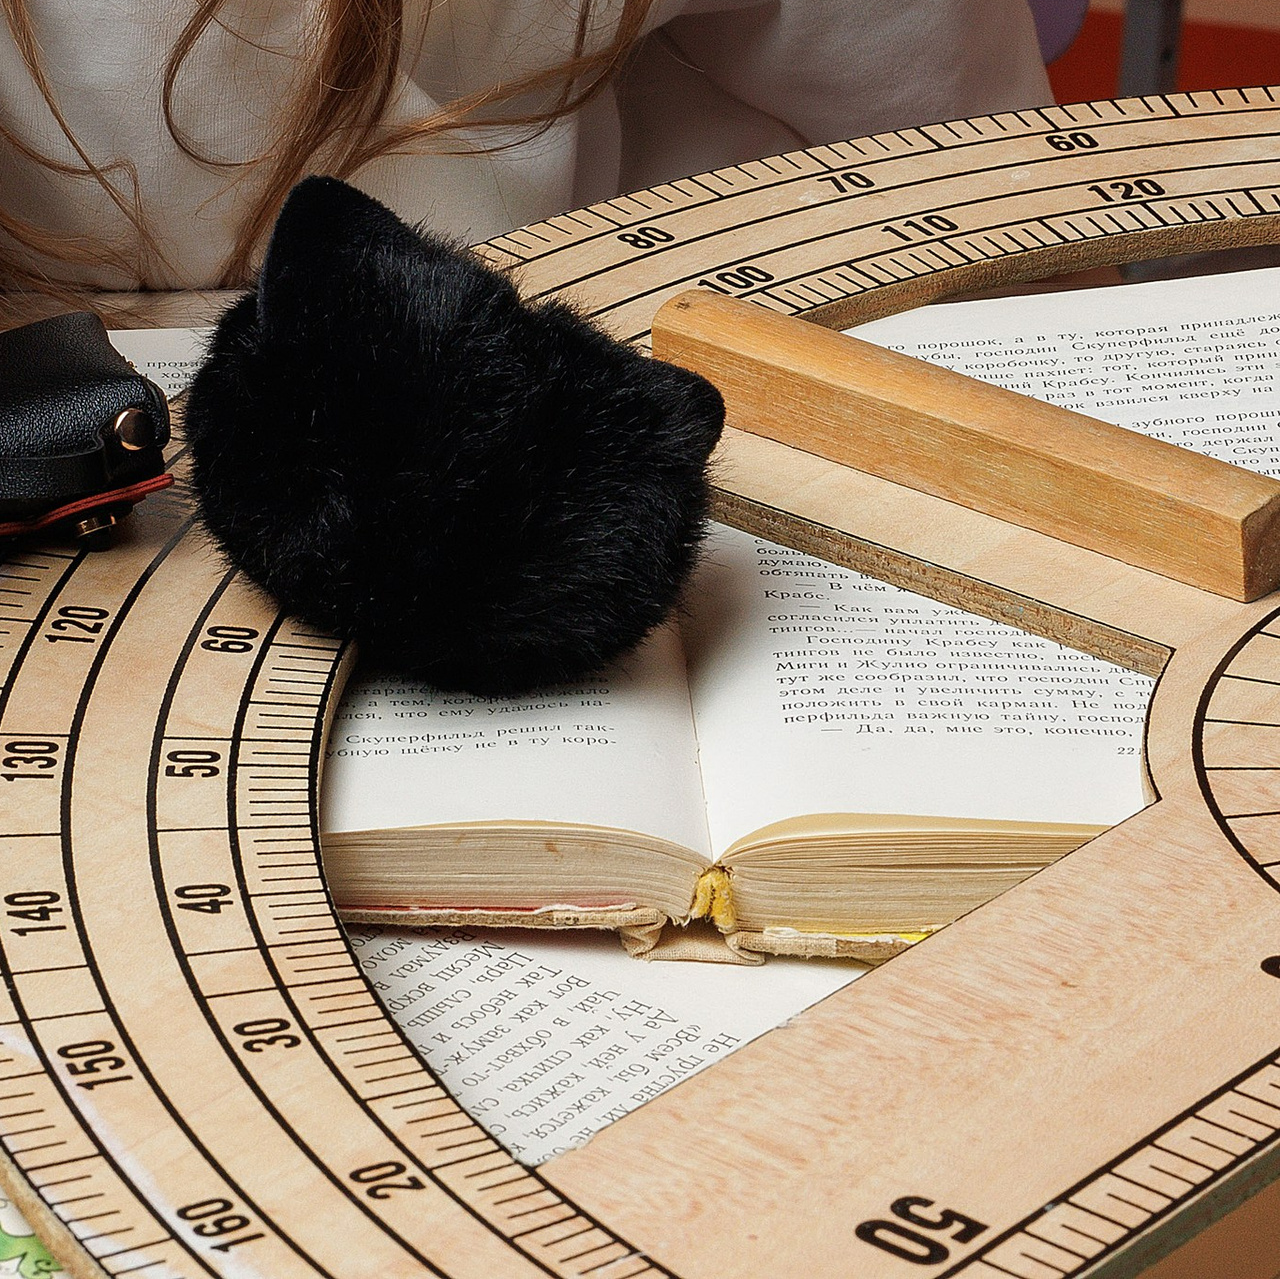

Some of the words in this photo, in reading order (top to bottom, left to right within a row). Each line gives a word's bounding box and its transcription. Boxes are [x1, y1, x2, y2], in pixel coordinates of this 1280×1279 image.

[1047, 130, 1100, 154] 60
[823, 171, 876, 195] 70
[1087, 177, 1166, 201] 120
[617, 226, 675, 251] 80
[881, 214, 959, 242] 110
[697, 266, 775, 294] 100
[917, 339, 1003, 351] порошок,
[1057, 331, 1083, 342] ту,
[1095, 325, 1168, 338] которая
[975, 345, 1057, 358] господин
[1072, 334, 1197, 351] Скуперфильд
[1209, 328, 1245, 339] ещё
[964, 359, 1065, 372] коробочку,
[1074, 355, 1094, 363] то
[1103, 348, 1175, 362] другую,
[1184, 341, 1267, 354] стараясь
[1024, 368, 1093, 378] пахнет:
[1102, 364, 1137, 372] тот,
[1147, 354, 1224, 367] который
[1126, 367, 1226, 381] Кончились
[1235, 364, 1265, 372] эти
[1045, 391, 1076, 401] раз
[1102, 387, 1132, 395] тот
[1141, 380, 1214, 392] момент,
[1223, 373, 1274, 385] когда
[1096, 394, 1169, 408] взвился
[1179, 387, 1242, 400] кверху
[1252, 385, 1273, 393] на
[1132, 416, 1205, 429] зубного
[1182, 423, 1267, 437] господин
[1202, 436, 1274, 447] держал
[757, 558, 829, 569] думаю,
[759, 568, 849, 579] обтяпать
[764, 590, 830, 601] Крабс.
[829, 582, 843, 590] В
[851, 583, 886, 592] чём
[767, 613, 879, 623] согласился
[889, 617, 980, 626] уплатить
[834, 604, 872, 613] Как
[45, 605, 112, 645] 120
[884, 627, 943, 635] начал
[200, 625, 262, 654] 60
[806, 635, 913, 647] Господину
[926, 638, 998, 648] Крабсу
[1012, 641, 1046, 649] как
[772, 648, 840, 659] тингов
[853, 648, 874, 656] не
[886, 648, 938, 657] было
[950, 650, 1045, 660] известно,
[775, 661, 829, 671] Миги
[856, 659, 928, 670] Жулио
[935, 661, 1101, 673] ограничивались
[776, 675, 809, 685] тут
[818, 674, 846, 682] же
[855, 672, 966, 683] сообразил,
[975, 675, 1008, 683] что
[1018, 676, 1110, 685] господин
[390, 699, 431, 707] тем,
[779, 687, 826, 697] этом
[837, 686, 882, 695] деле
[917, 686, 1022, 696] увеличить
[1034, 688, 1103, 699] сумму,
[782, 699, 882, 710] положить
[917, 698, 964, 707] свой
[977, 700, 1059, 710] карман.
[1071, 700, 1100, 709] Не
[394, 711, 428, 719] что
[439, 708, 475, 717] ему
[487, 701, 569, 716] удалось
[580, 699, 611, 707] на-
[783, 712, 895, 724] перфильда
[907, 712, 990, 722] важную
[1001, 712, 1067, 723] тайну,
[346, 730, 485, 746] Скуперфильд
[497, 724, 561, 737] решил
[573, 724, 615, 732] так-
[856, 724, 893, 734] Да,
[904, 725, 935, 734] да,
[946, 726, 983, 734] мне
[993, 726, 1034, 735] это,
[1045, 727, 1133, 737] конечно,
[401, 744, 464, 755] щётку
[475, 741, 497, 749] не
[529, 737, 550, 746] ту
[562, 736, 617, 746] коро-
[0, 740, 61, 783] 130
[165, 749, 222, 779] 50
[176, 882, 233, 915] 40
[3, 889, 67, 938] 140
[388, 929, 477, 980] Вздумал
[429, 940, 506, 982] Месяц
[470, 952, 534, 984] Царь,
[514, 964, 562, 990] Так
[547, 975, 591, 999] Вот
[401, 989, 472, 1029] слышь,
[451, 989, 519, 1030] небось
[509, 999, 549, 1024] как
[566, 990, 621, 1014] Чай,
[605, 999, 652, 1020] Ну,
[552, 1016, 571, 1027] в
[643, 1008, 679, 1030] Да
[232, 1016, 302, 1053] 30
[431, 1031, 453, 1044] и
[570, 1024, 611, 1048] как
[625, 1030, 647, 1043] у
[643, 1024, 702, 1062] «Всем
[702, 1032, 741, 1053] Не
[57, 1039, 134, 1091] 150
[462, 1029, 553, 1087] обхват-то
[581, 1043, 628, 1070] ней,
[497, 1049, 572, 1092] спичка,
[607, 1063, 650, 1084] бы,
[630, 1054, 705, 1103] грустна
[504, 1072, 586, 1118] кажись,
[523, 1086, 612, 1139] кажется,
[348, 1161, 426, 1200] 20
[176, 1197, 265, 1254] 160
[855, 1196, 988, 1266] 50
